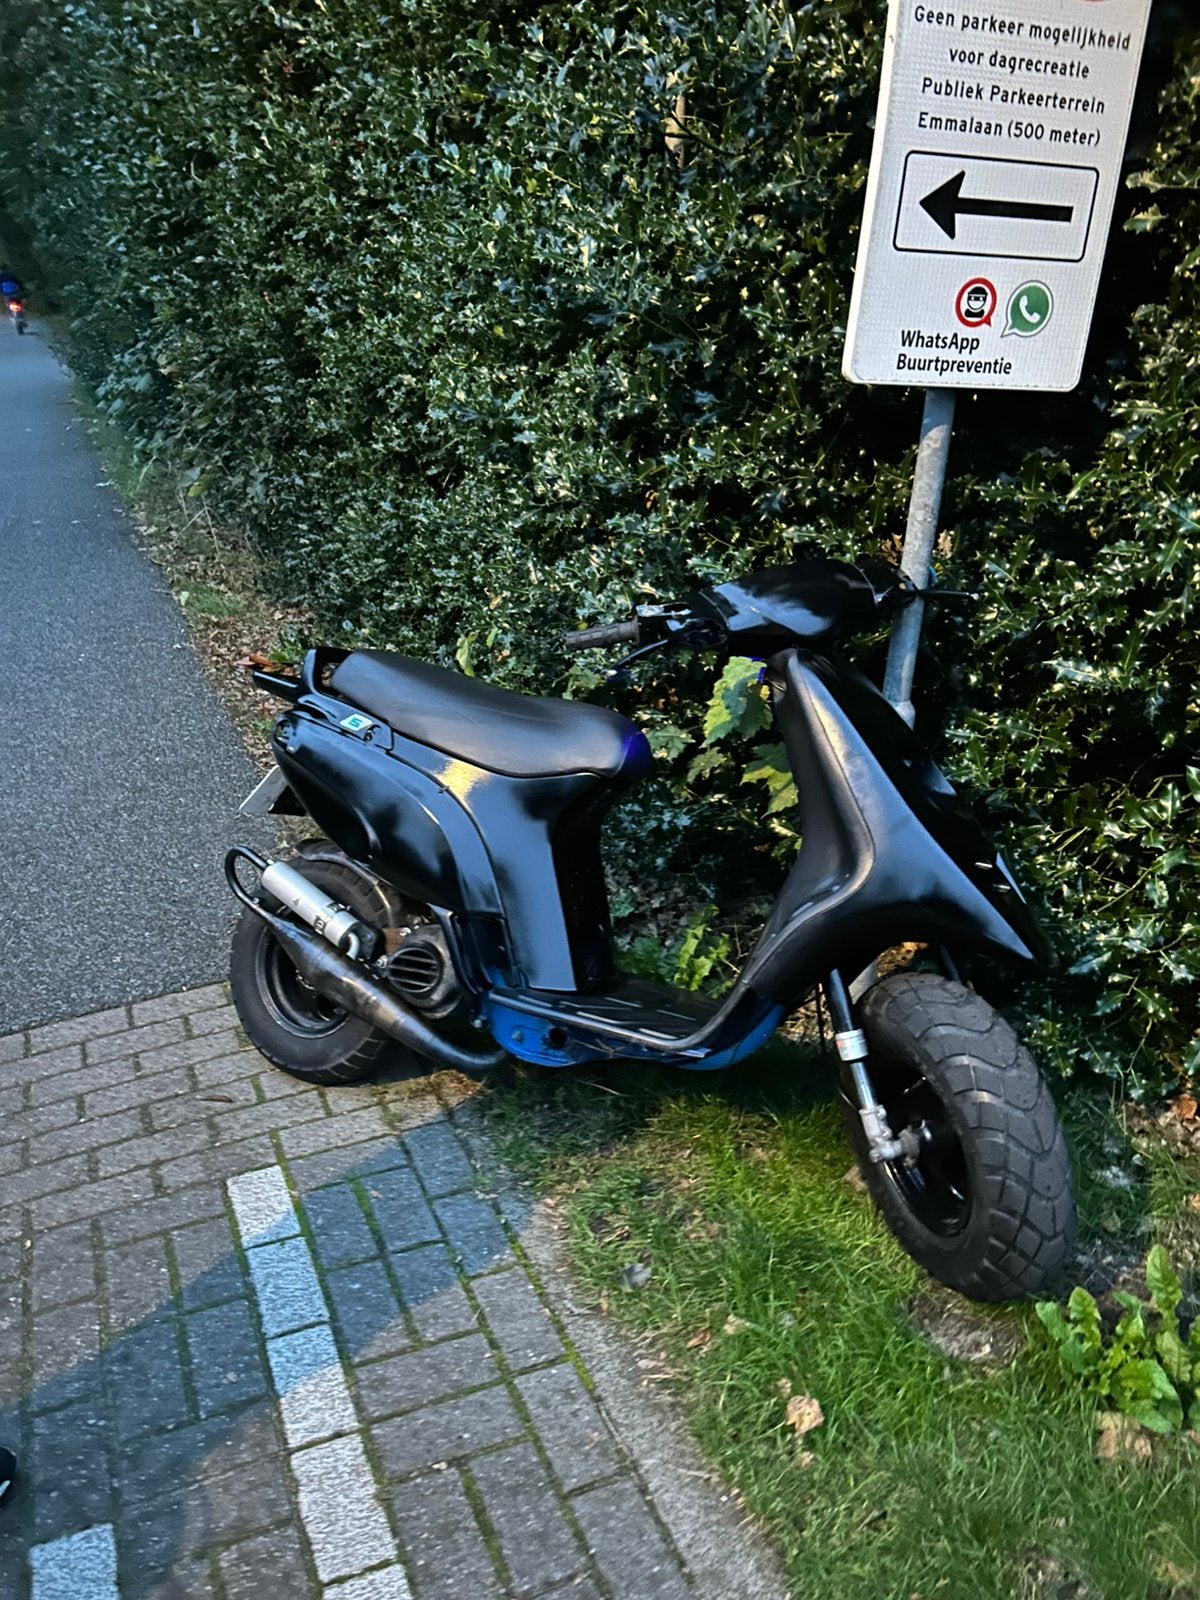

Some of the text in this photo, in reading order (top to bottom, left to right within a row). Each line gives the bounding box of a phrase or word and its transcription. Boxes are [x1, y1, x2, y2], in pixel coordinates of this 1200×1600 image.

[915, 5, 1131, 50] Geen parkeer mogelijkheid
[950, 48, 1090, 80] voor dagrecreatie
[922, 77, 1105, 114] Publiek Parkeerterrein
[918, 112, 1101, 147] Emmalaan (500 meter)
[901, 329, 981, 355] WhatsApp
[896, 353, 1012, 375] Buurtpreventie
